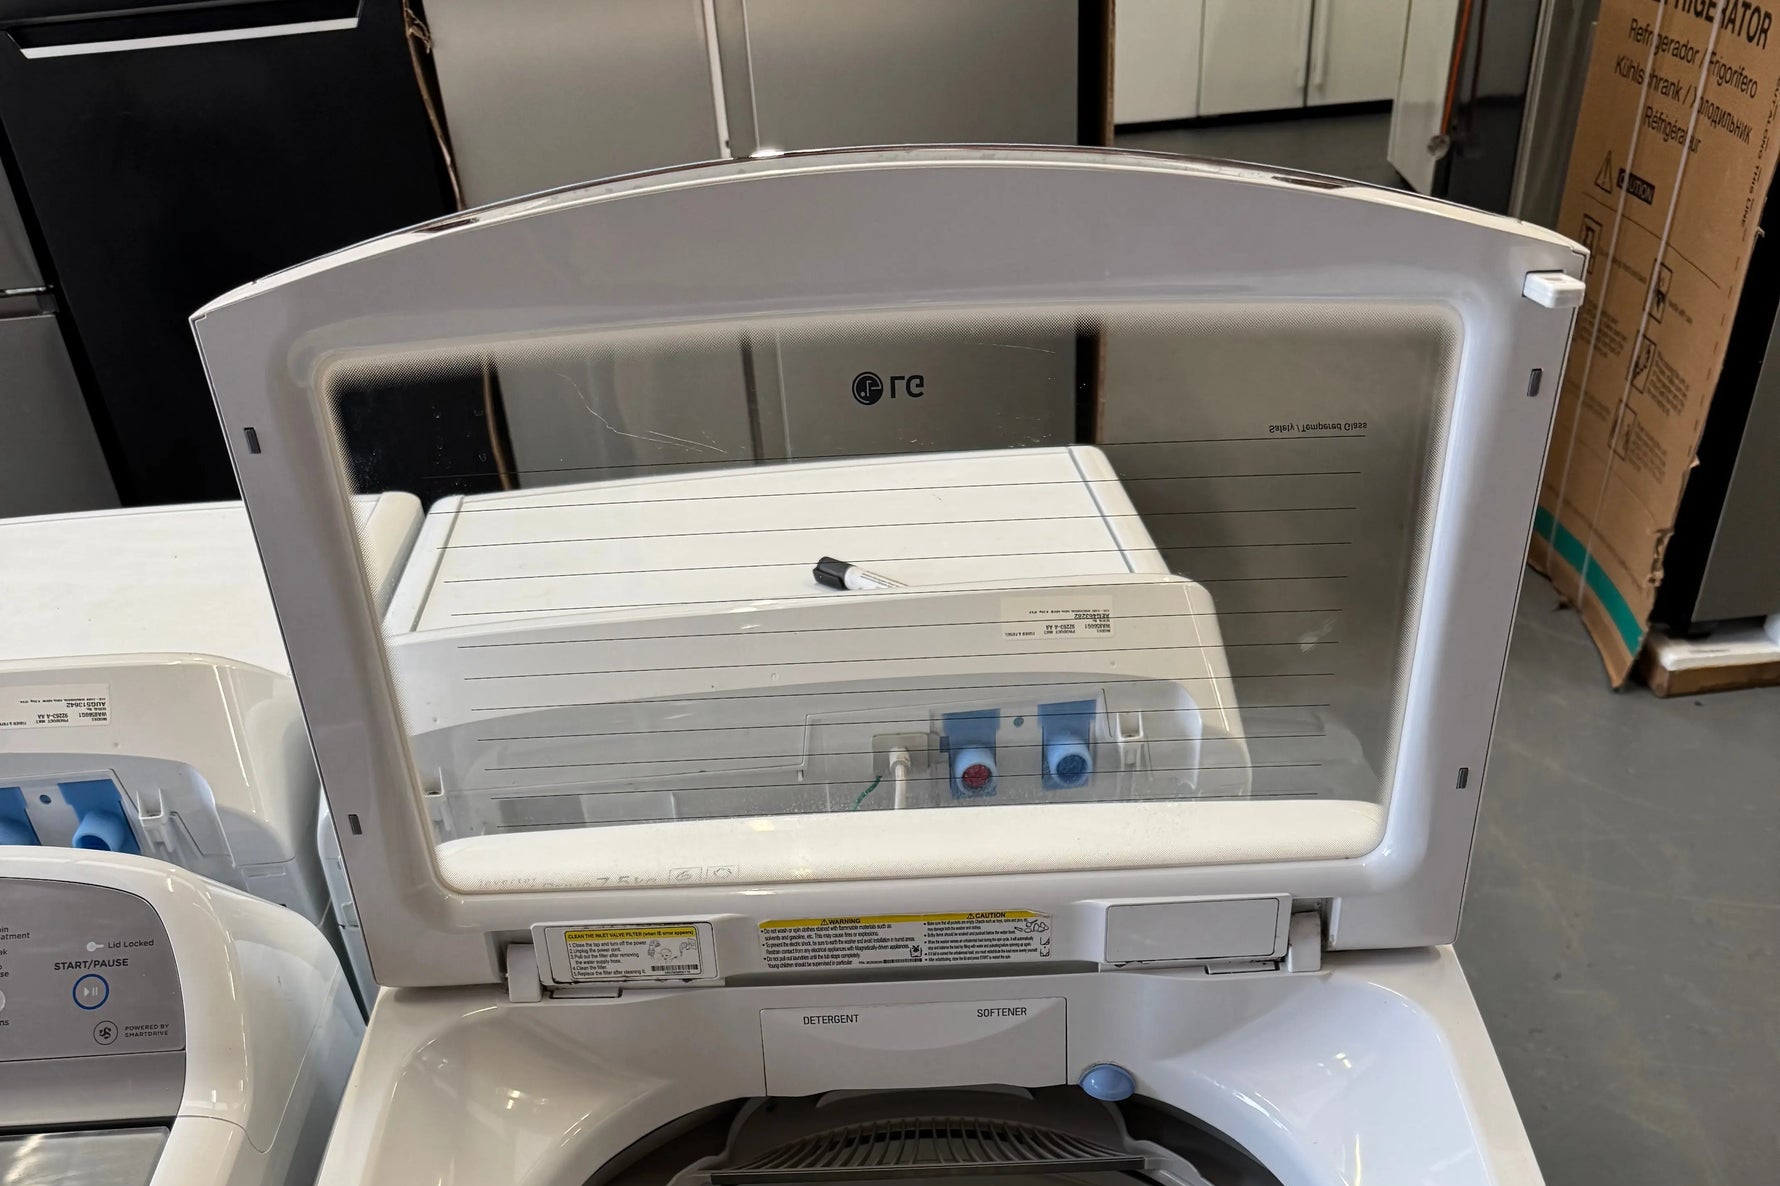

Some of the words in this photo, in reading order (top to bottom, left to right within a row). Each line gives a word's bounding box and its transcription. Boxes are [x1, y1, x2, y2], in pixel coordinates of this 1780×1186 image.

[1628, 17, 1700, 66] Refrgerador
[1614, 54, 1683, 103] Kühlshrank
[107, 940, 121, 949] Lid
[123, 939, 155, 948] Locked
[54, 958, 129, 971] START/PAUSE
[976, 1006, 1028, 1018] SOFTENER
[802, 1013, 860, 1026] DETERGENT
[124, 1030, 169, 1038] SMARTDRIVE
